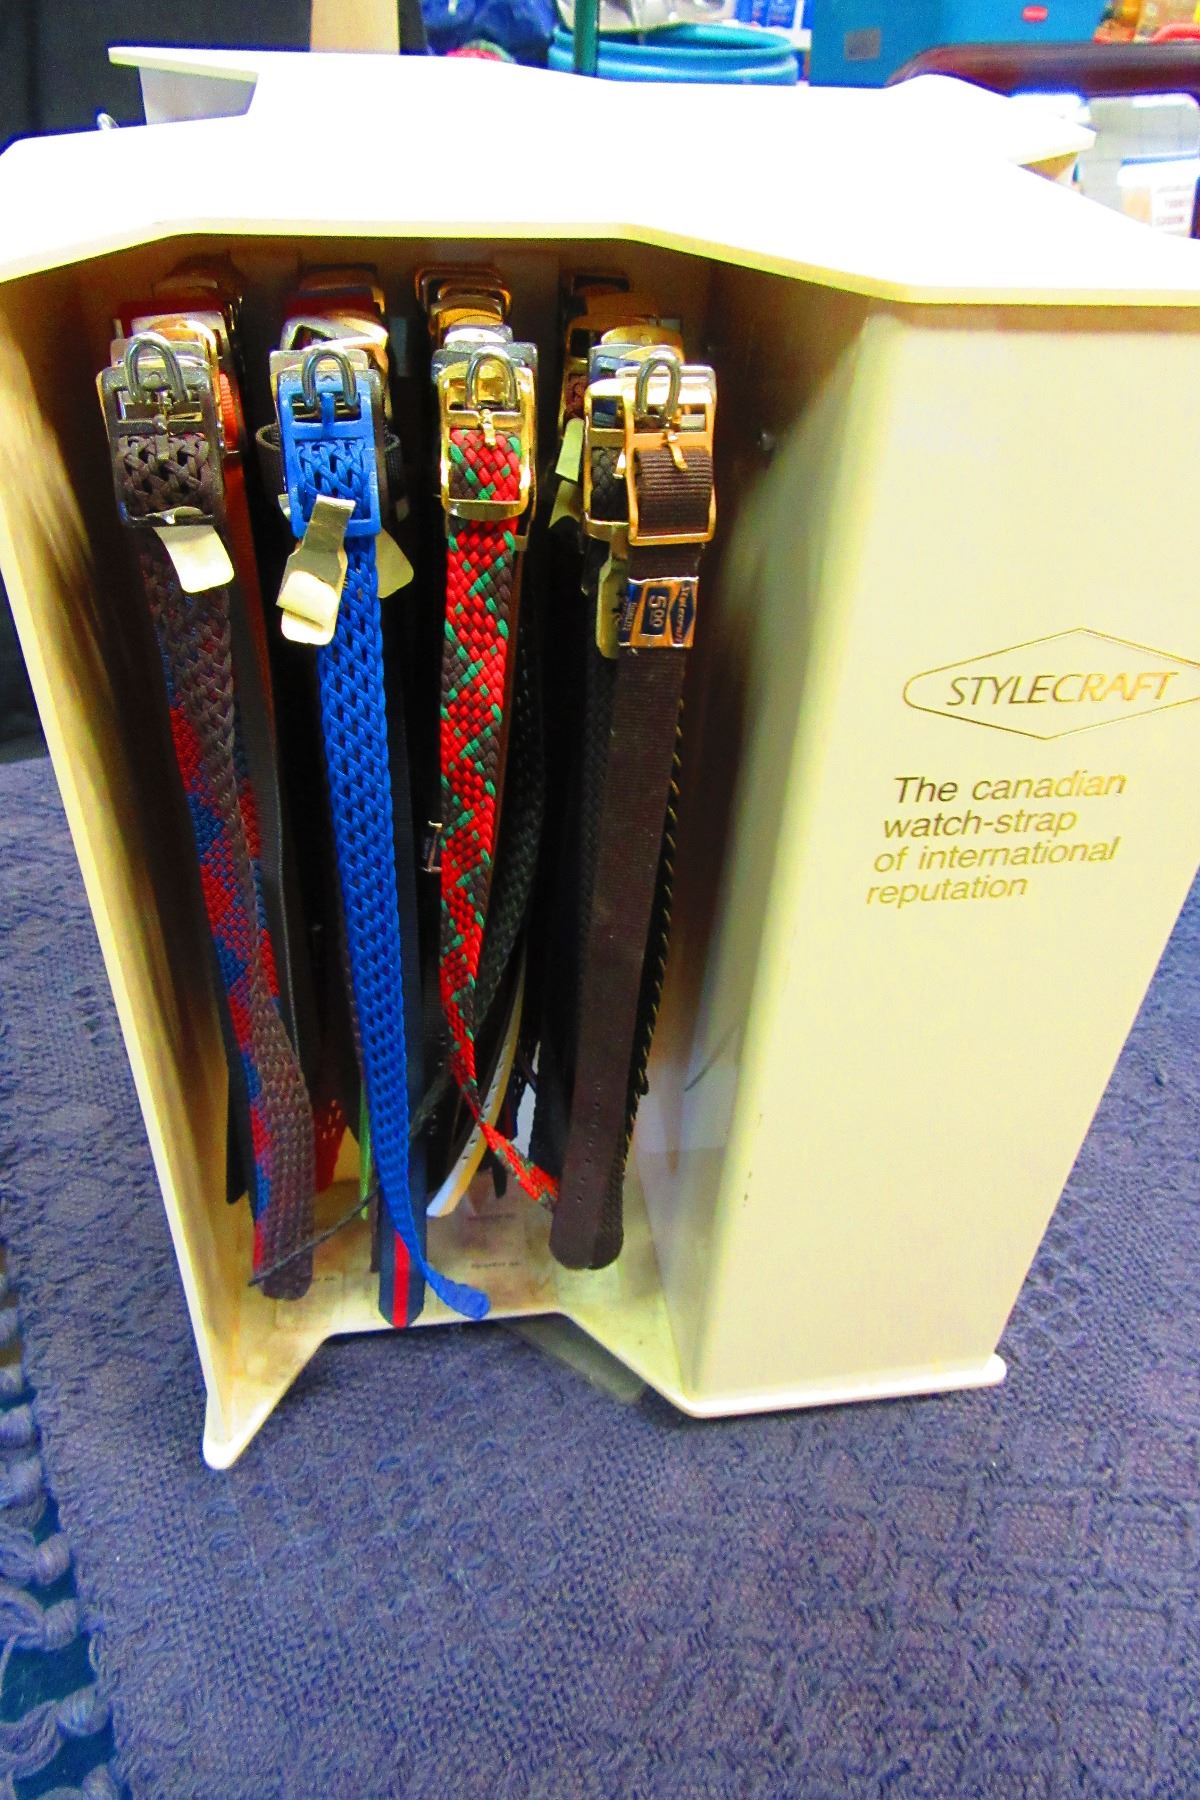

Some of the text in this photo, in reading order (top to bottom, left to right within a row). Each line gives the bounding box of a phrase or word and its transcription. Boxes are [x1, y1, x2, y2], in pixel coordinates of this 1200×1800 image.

[946, 671, 1178, 706] STYLECRAFT
[894, 769, 1128, 804] The canadian
[883, 809, 1078, 839] watch-strap
[873, 836, 1121, 873] of international
[865, 874, 1029, 909] reputation
